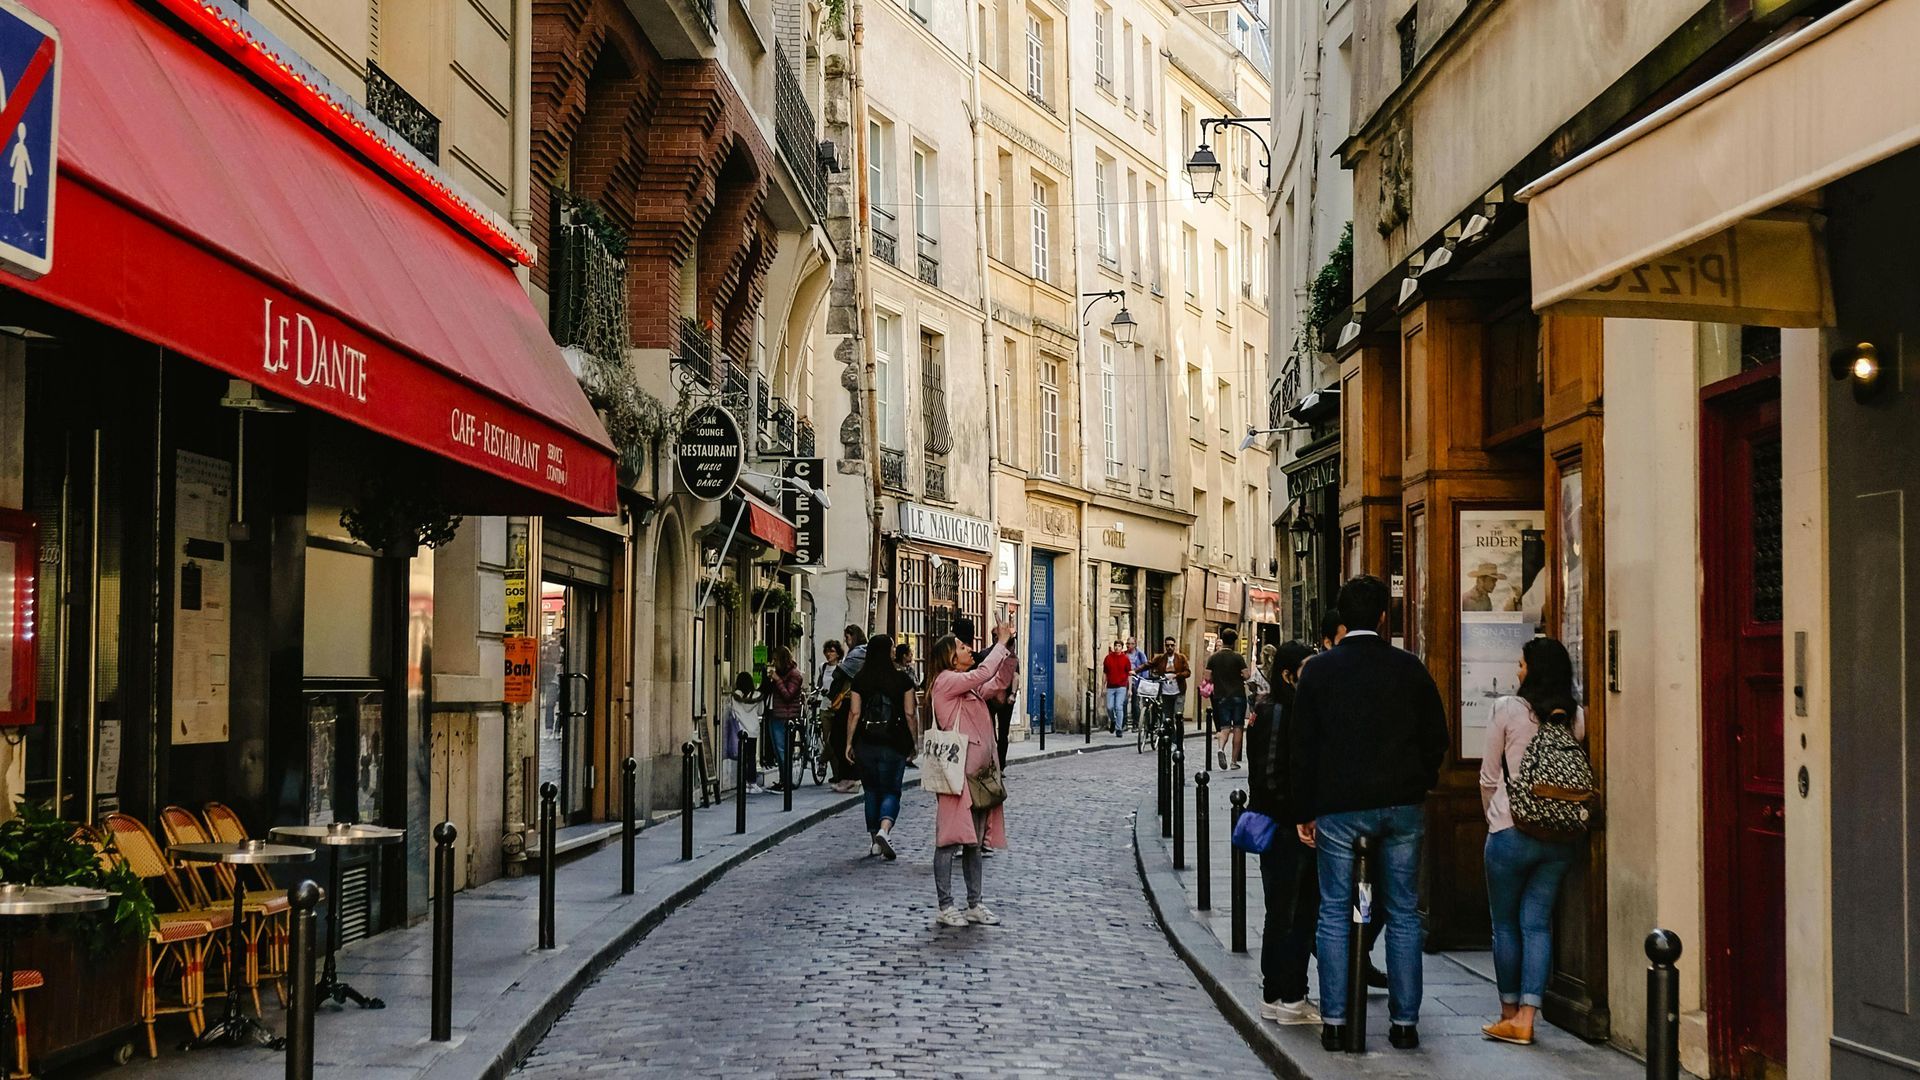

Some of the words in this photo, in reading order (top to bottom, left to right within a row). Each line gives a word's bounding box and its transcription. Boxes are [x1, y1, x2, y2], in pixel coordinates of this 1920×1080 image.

[451, 408, 476, 447] CAFE
[483, 421, 540, 472] RESTAURANT
[681, 444, 738, 457] RESTAURANT
[696, 463, 722, 471] MUSIC
[696, 479, 723, 487] DANCE
[794, 462, 810, 564] CÊPES
[911, 508, 925, 535] LE
[930, 512, 990, 548] NAVIGATOR
[1476, 536, 1518, 547] RIDER
[1471, 627, 1521, 639] SONATE
